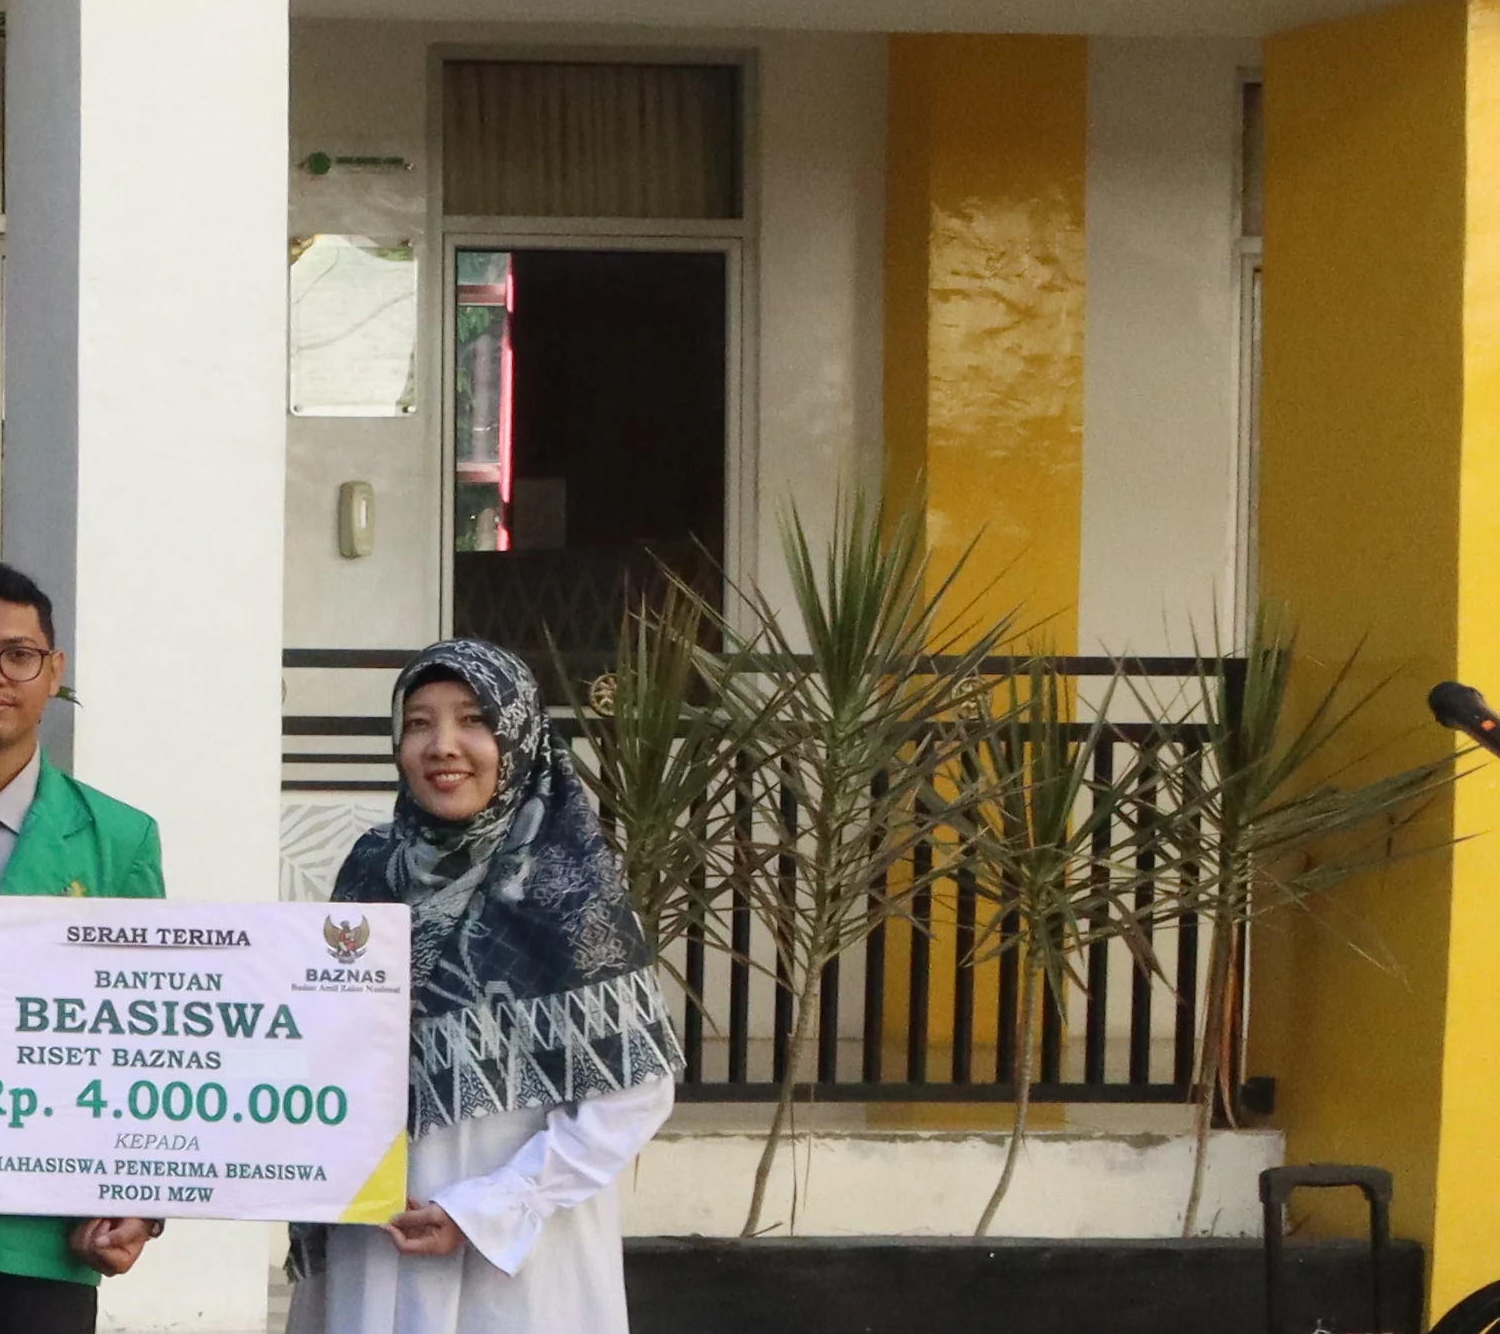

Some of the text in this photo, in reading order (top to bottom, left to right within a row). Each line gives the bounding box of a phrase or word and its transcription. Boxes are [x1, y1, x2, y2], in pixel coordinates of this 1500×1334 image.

[67, 926, 251, 947] SERAH TERIMA
[95, 971, 222, 991] BANTUAN
[306, 969, 385, 983] BAZNAS
[16, 997, 302, 1039] BEASISWA
[17, 1046, 221, 1069] RISET BAZNAS
[77, 1080, 347, 1125] 4.000.000
[114, 1134, 199, 1151] KEPADA
[115, 1160, 218, 1178] PENERIMA
[226, 1163, 326, 1180] BEASISWA
[99, 1184, 214, 1202] PRODI MZW
